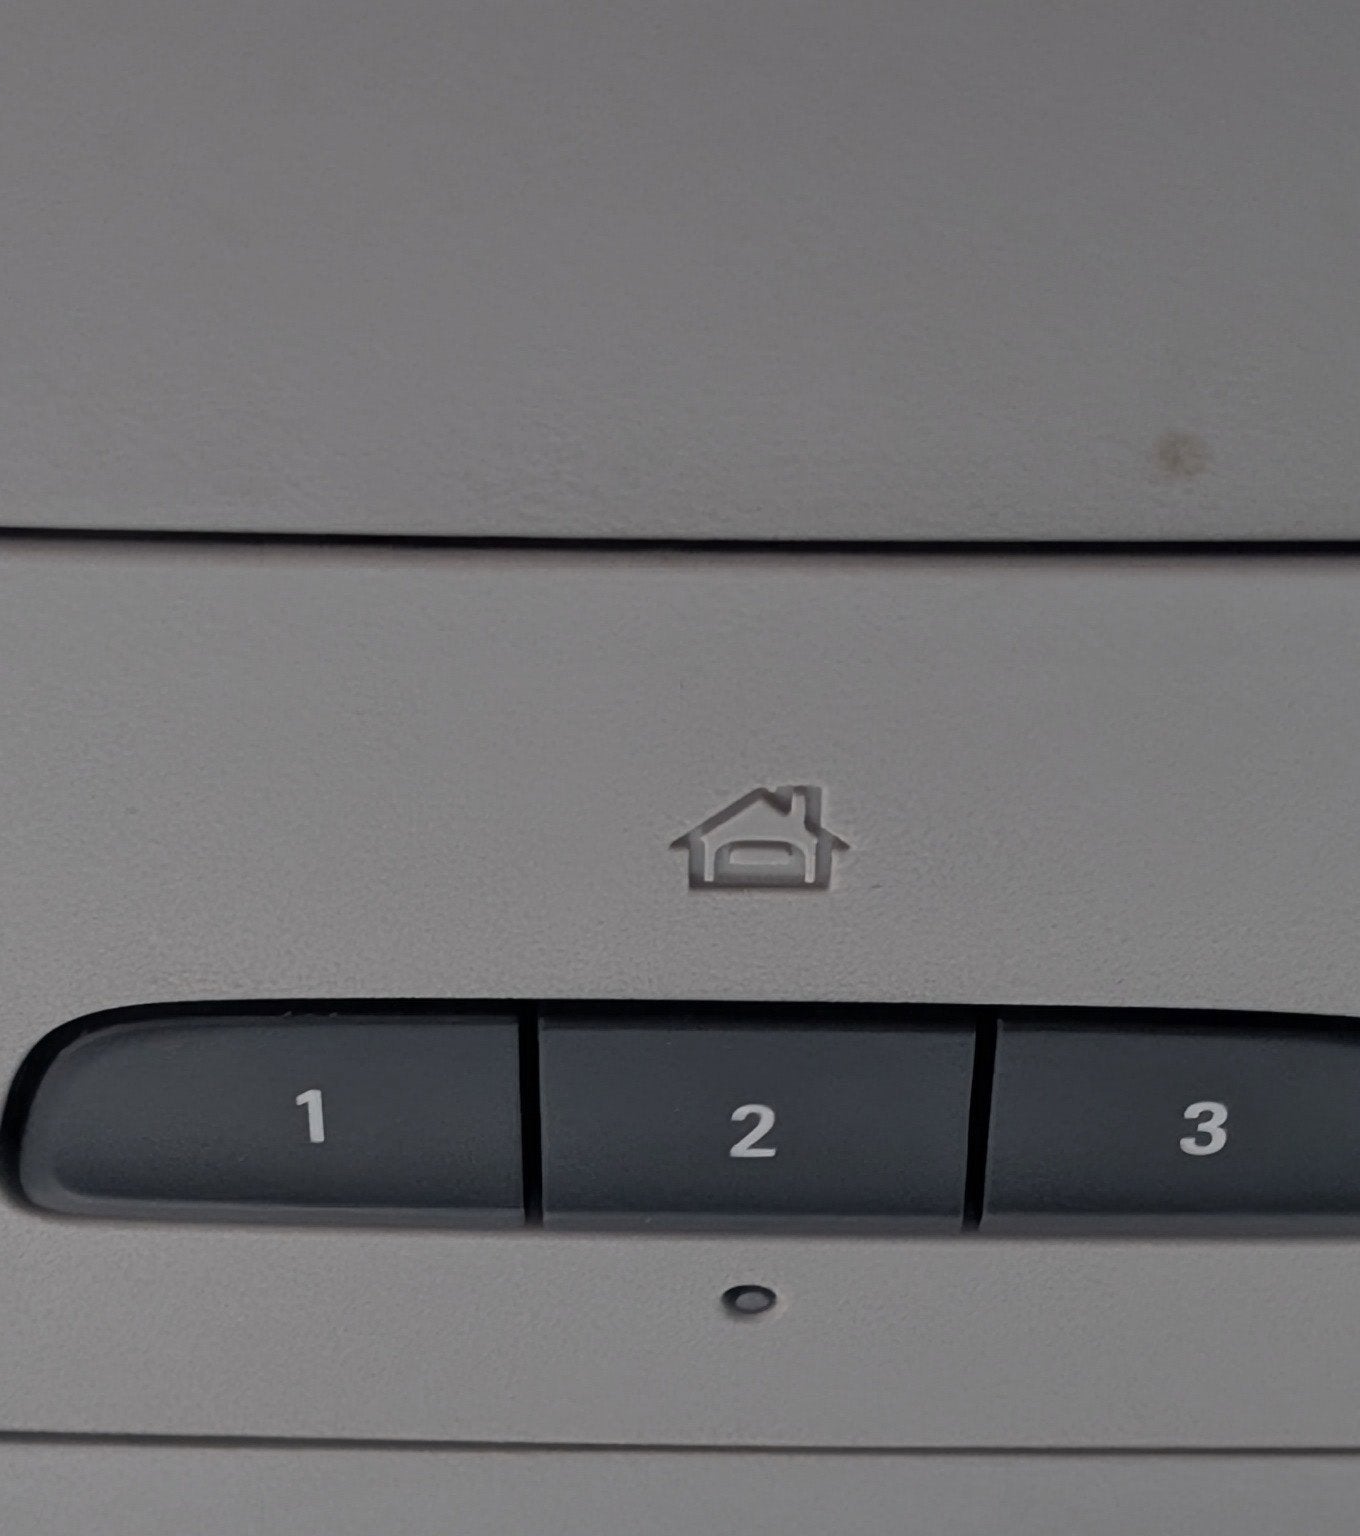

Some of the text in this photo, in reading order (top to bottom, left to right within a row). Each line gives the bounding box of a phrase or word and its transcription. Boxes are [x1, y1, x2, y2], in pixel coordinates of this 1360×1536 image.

[295, 1089, 325, 1144] 1
[729, 1103, 777, 1158] 2
[1179, 1101, 1228, 1156] 3
